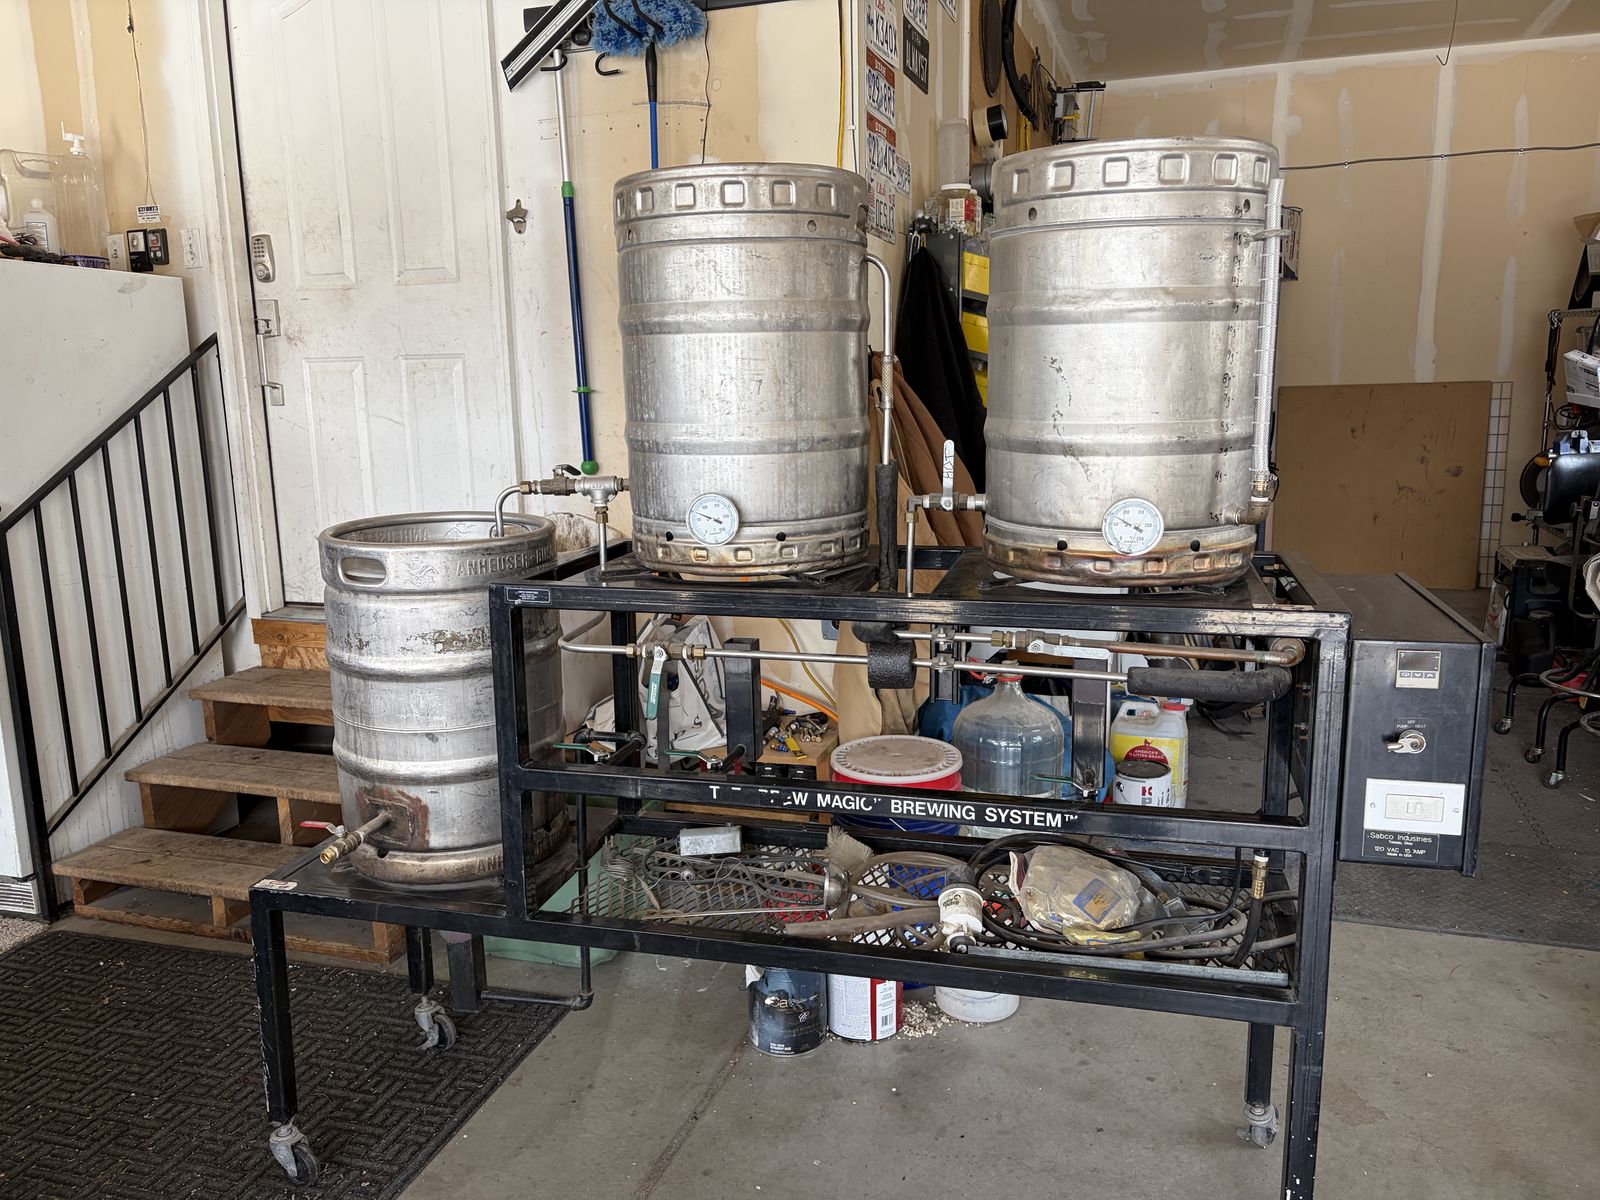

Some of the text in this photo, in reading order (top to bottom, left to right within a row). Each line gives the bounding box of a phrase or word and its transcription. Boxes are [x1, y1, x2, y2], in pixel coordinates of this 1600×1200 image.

[890, 799, 976, 821] BREWING
[1370, 831, 1433, 844] Sabco Industries
